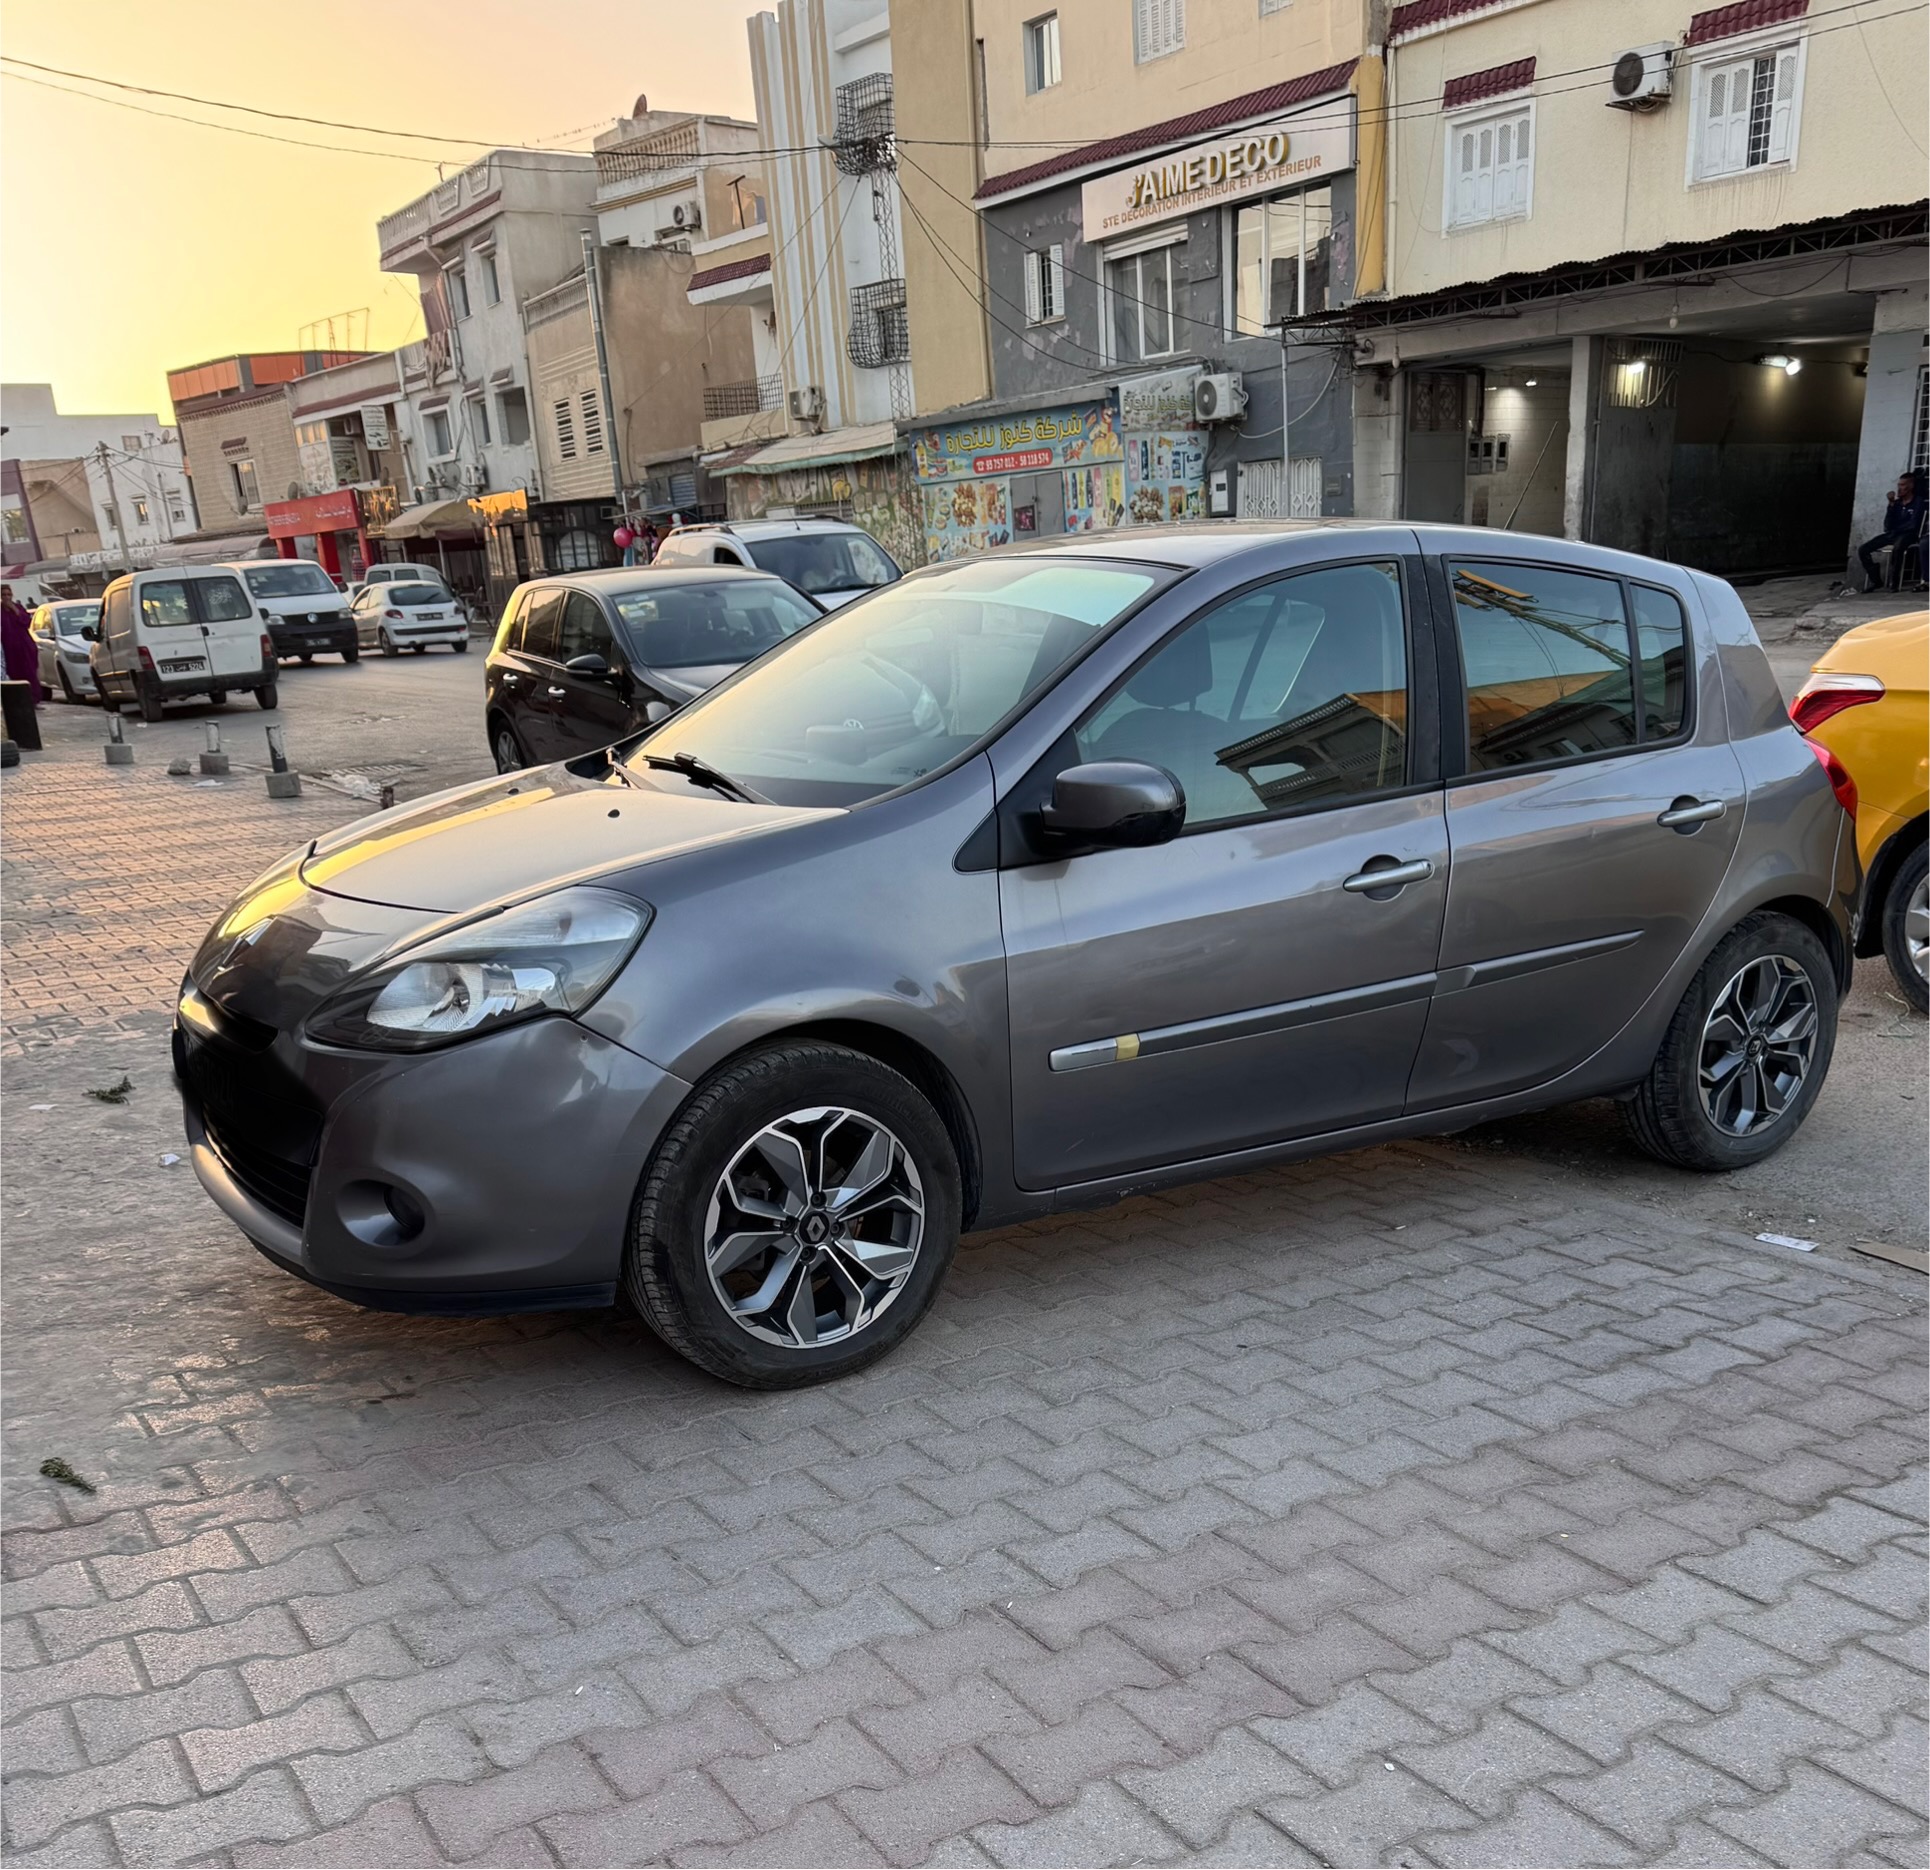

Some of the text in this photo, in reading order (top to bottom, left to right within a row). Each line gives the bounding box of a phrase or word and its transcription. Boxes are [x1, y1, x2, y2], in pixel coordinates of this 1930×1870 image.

[1206, 132, 1288, 184] DECO
[1102, 214, 1120, 229] STE
[1240, 174, 1253, 189] ET
[945, 409, 1083, 456] شركة كنوز للتجارة
